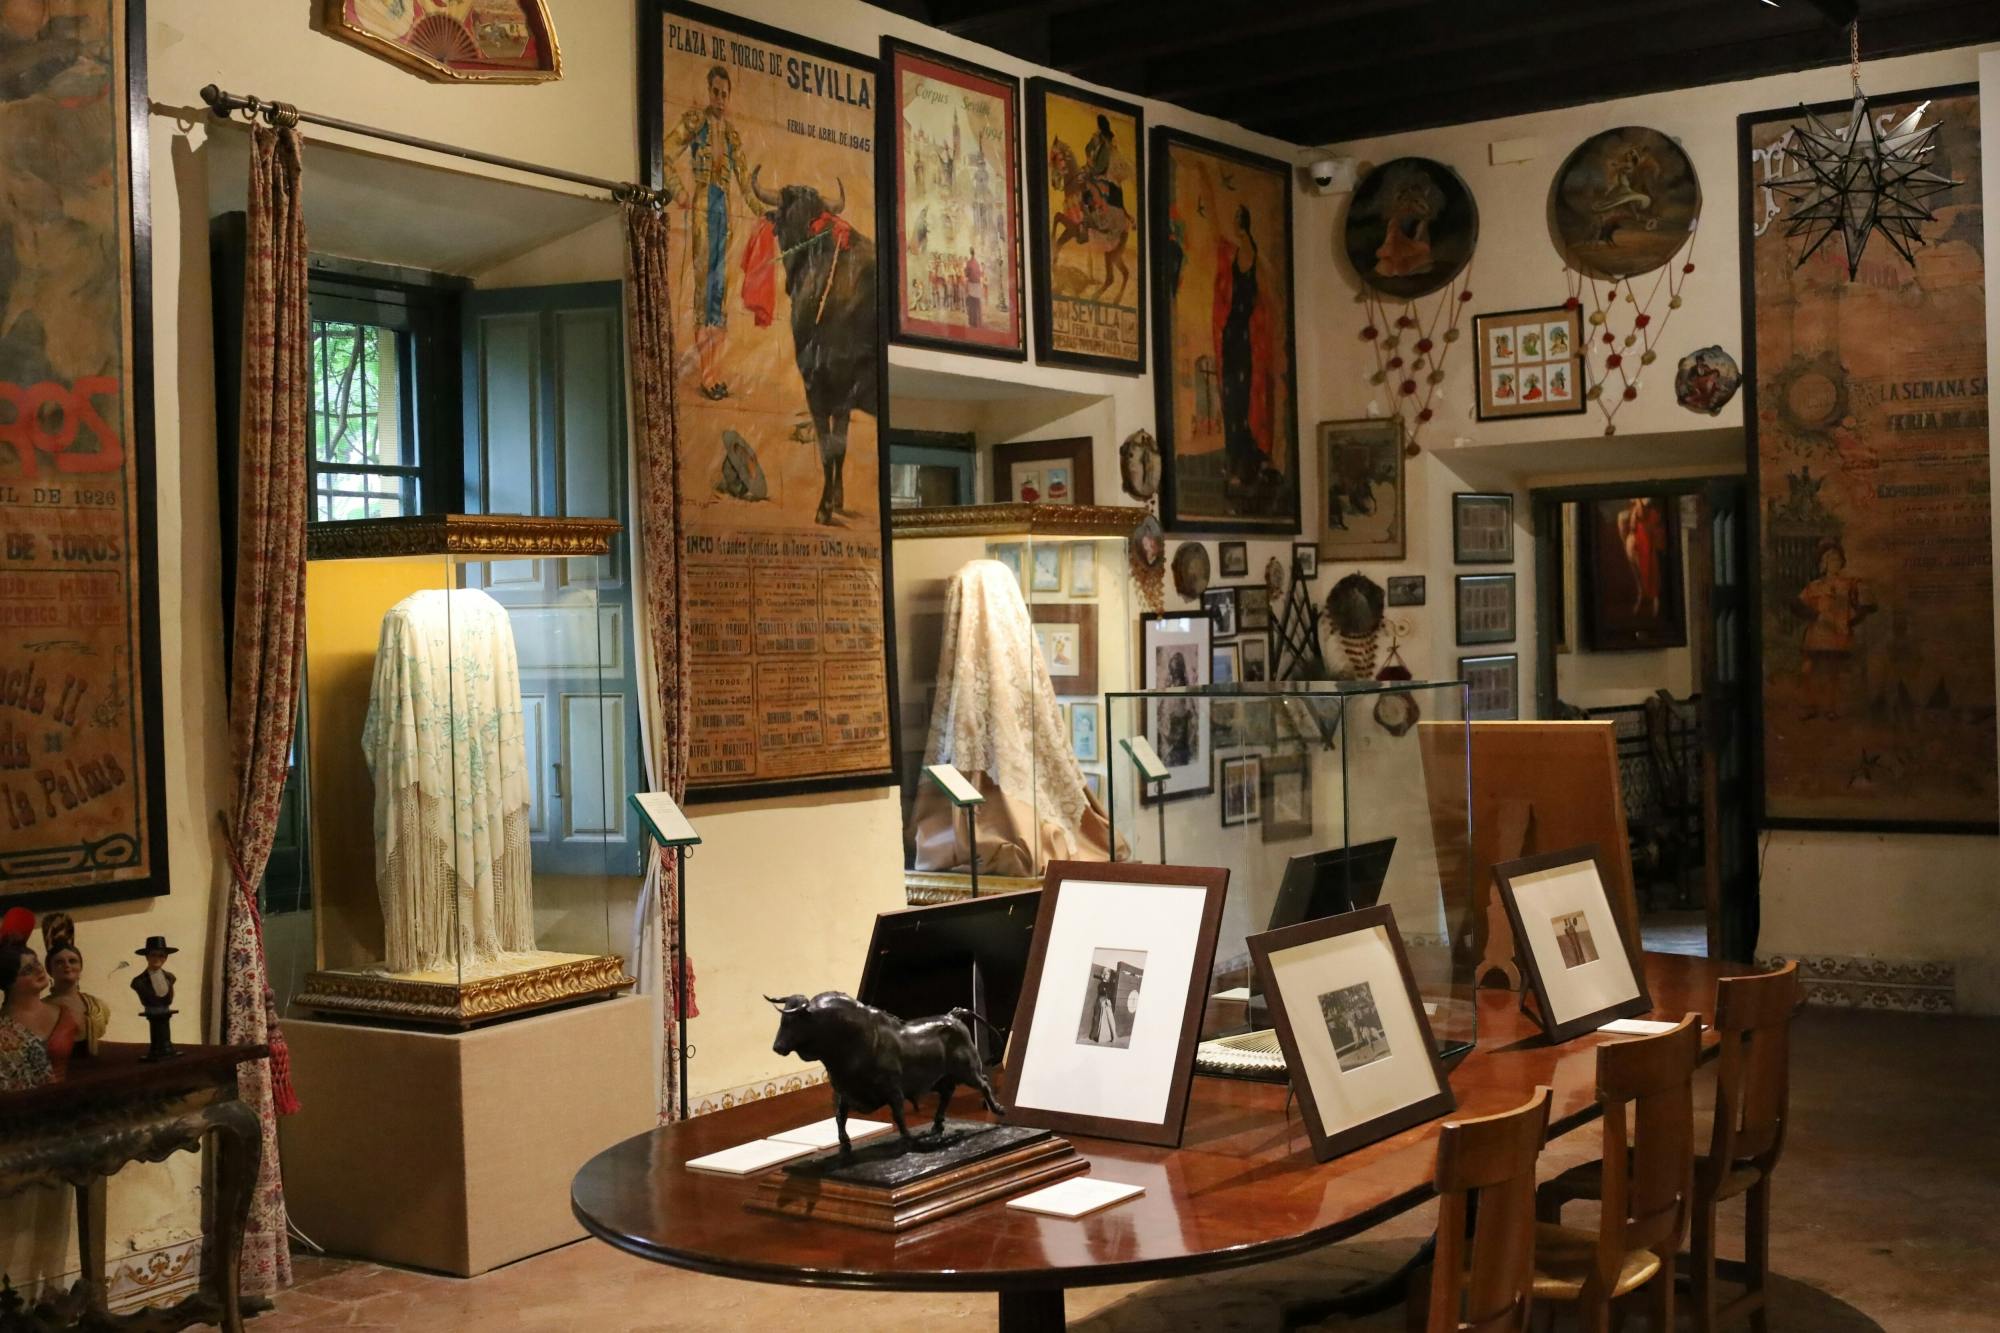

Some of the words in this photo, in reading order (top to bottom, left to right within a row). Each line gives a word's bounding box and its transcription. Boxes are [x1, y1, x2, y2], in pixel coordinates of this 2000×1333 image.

[669, 24, 707, 57] PLAZA
[712, 36, 727, 62] DE
[731, 41, 765, 72] TOROS
[769, 54, 783, 77] DE
[787, 57, 871, 109] SEVILLA
[915, 82, 949, 104] Corpus
[787, 118, 805, 136] FERIA
[808, 124, 817, 138] DE
[818, 127, 837, 144] ABRIL
[850, 135, 871, 153] 1945
[1880, 381, 1899, 401] LA
[1903, 379, 1966, 400] SEMANA
[33, 487, 62, 505] DE
[6, 533, 36, 561] DE
[47, 533, 121, 564] TOROS
[686, 535, 713, 554] INCO
[34, 753, 126, 819] Palma
